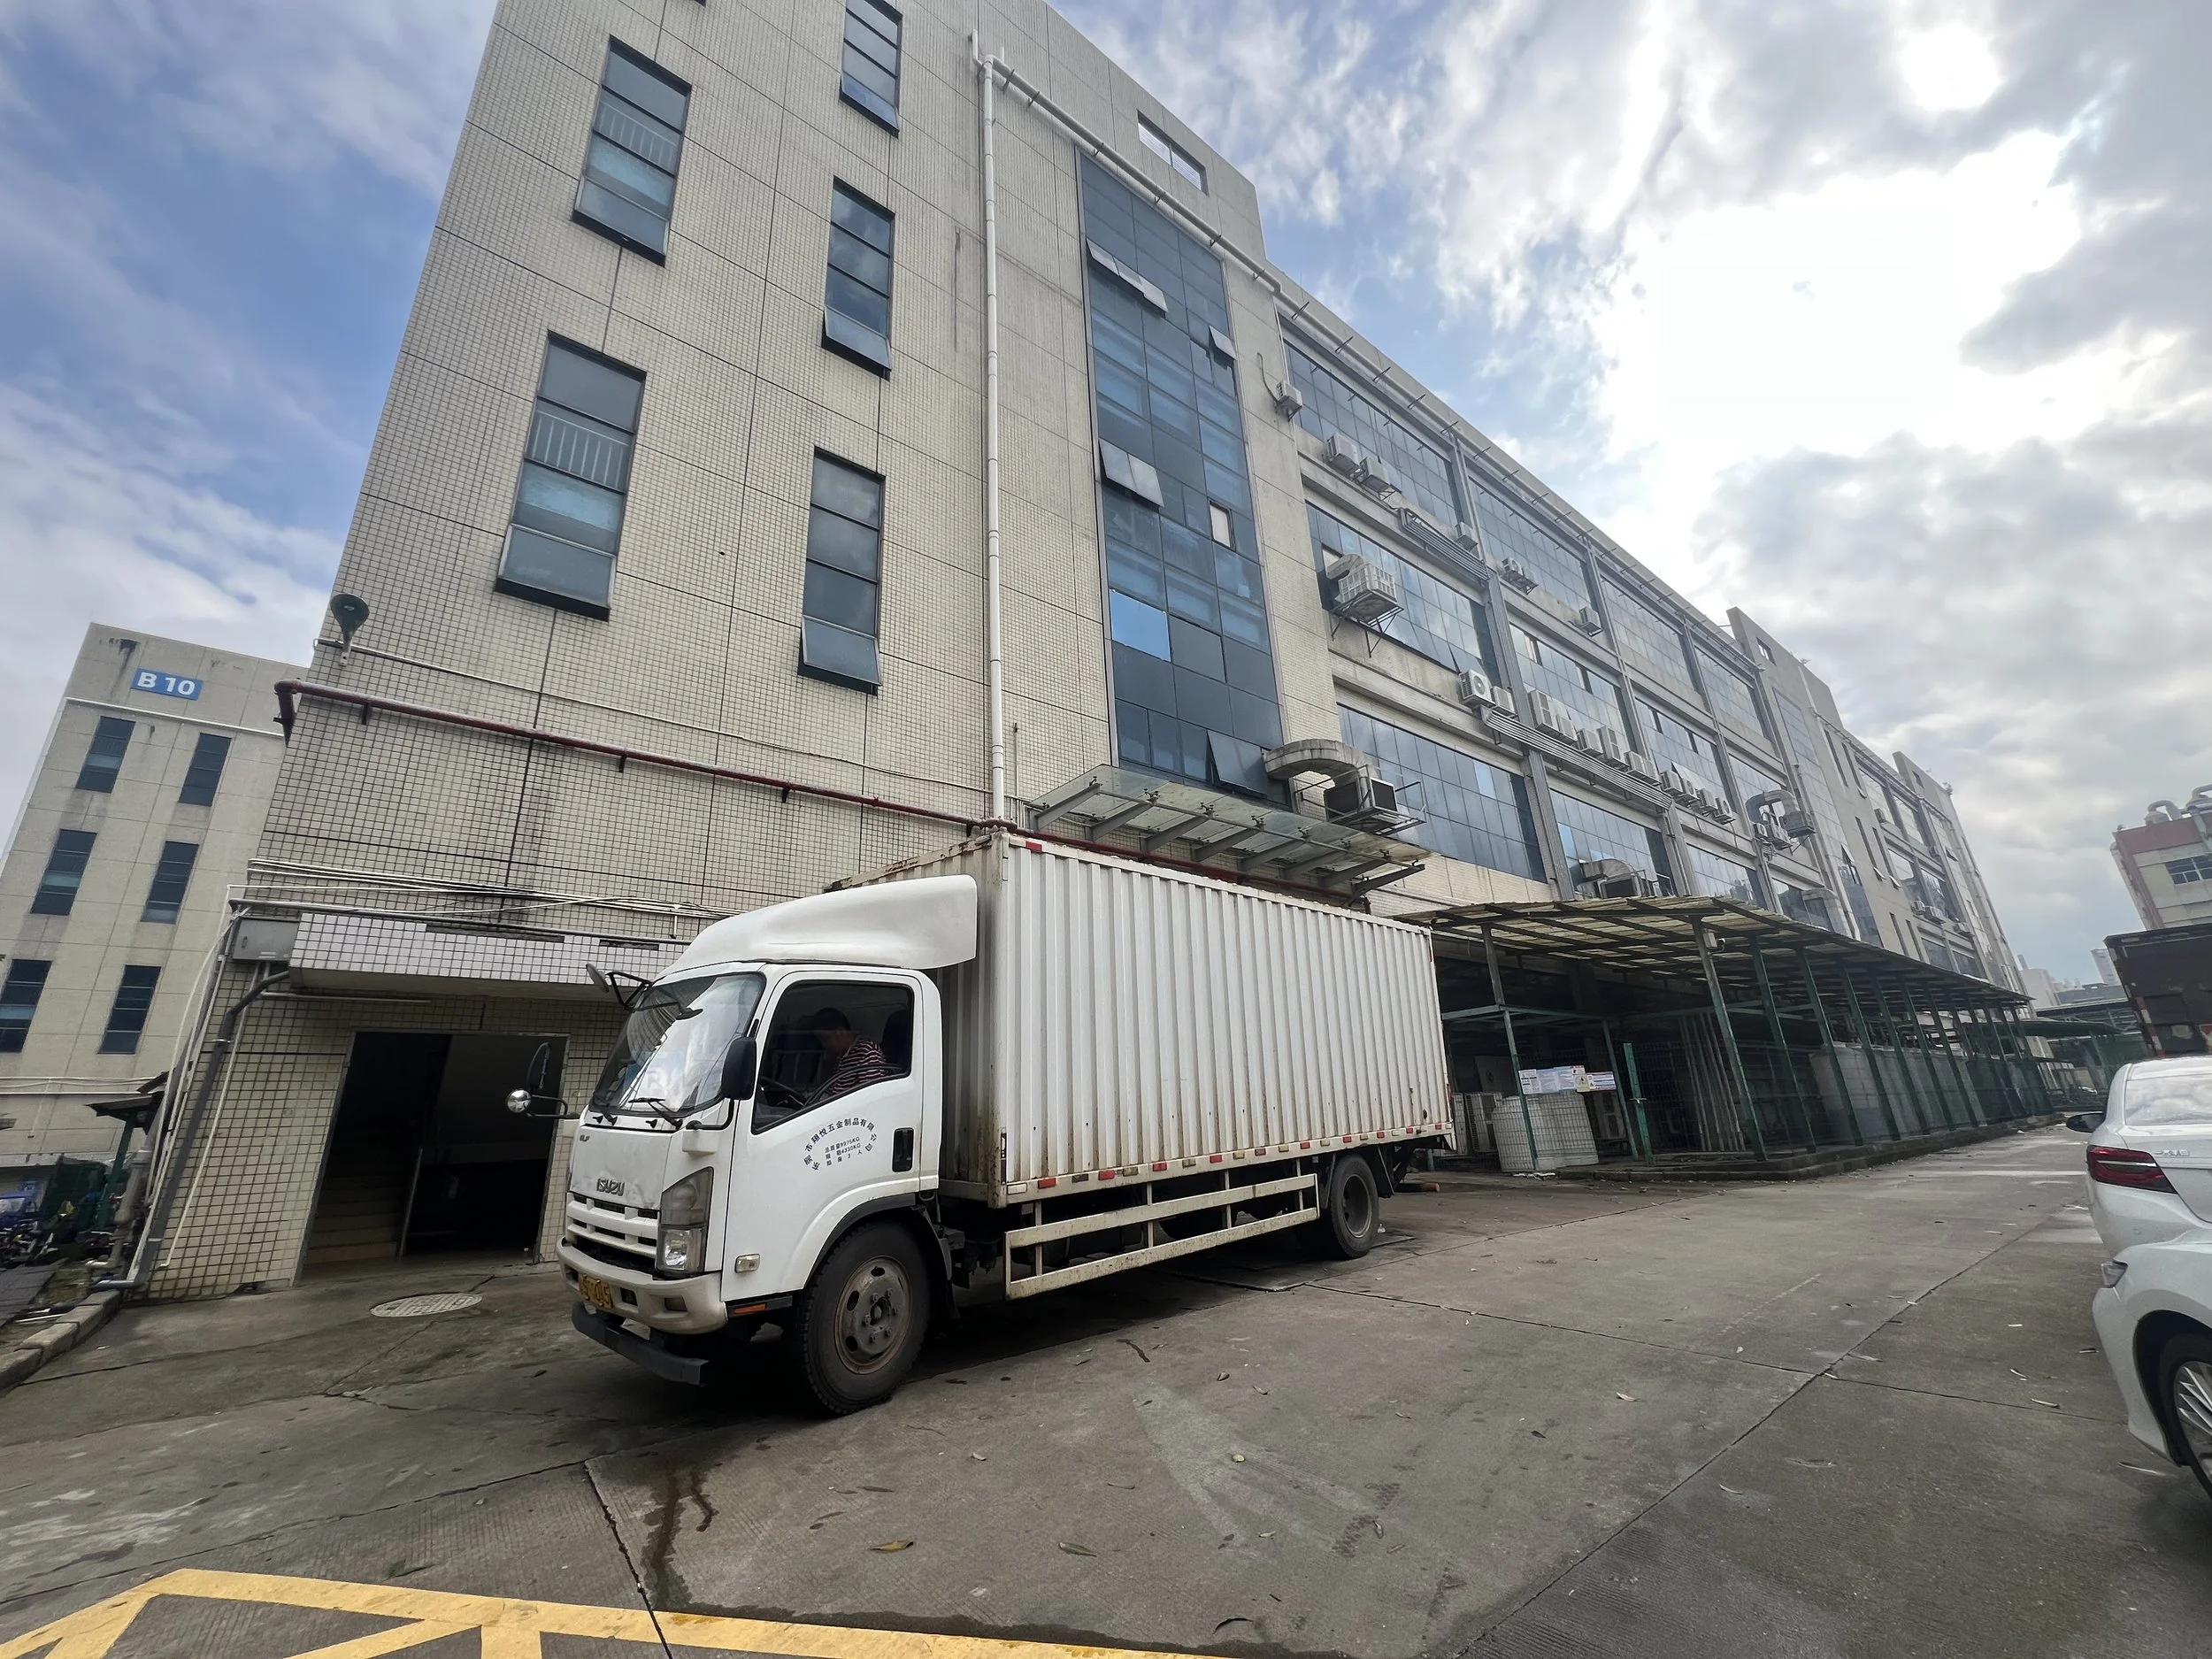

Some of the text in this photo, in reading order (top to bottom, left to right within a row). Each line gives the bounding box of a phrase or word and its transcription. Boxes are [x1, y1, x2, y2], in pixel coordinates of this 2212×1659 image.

[137, 672, 196, 695] B 10
[596, 1178, 625, 1196] ISUZU
